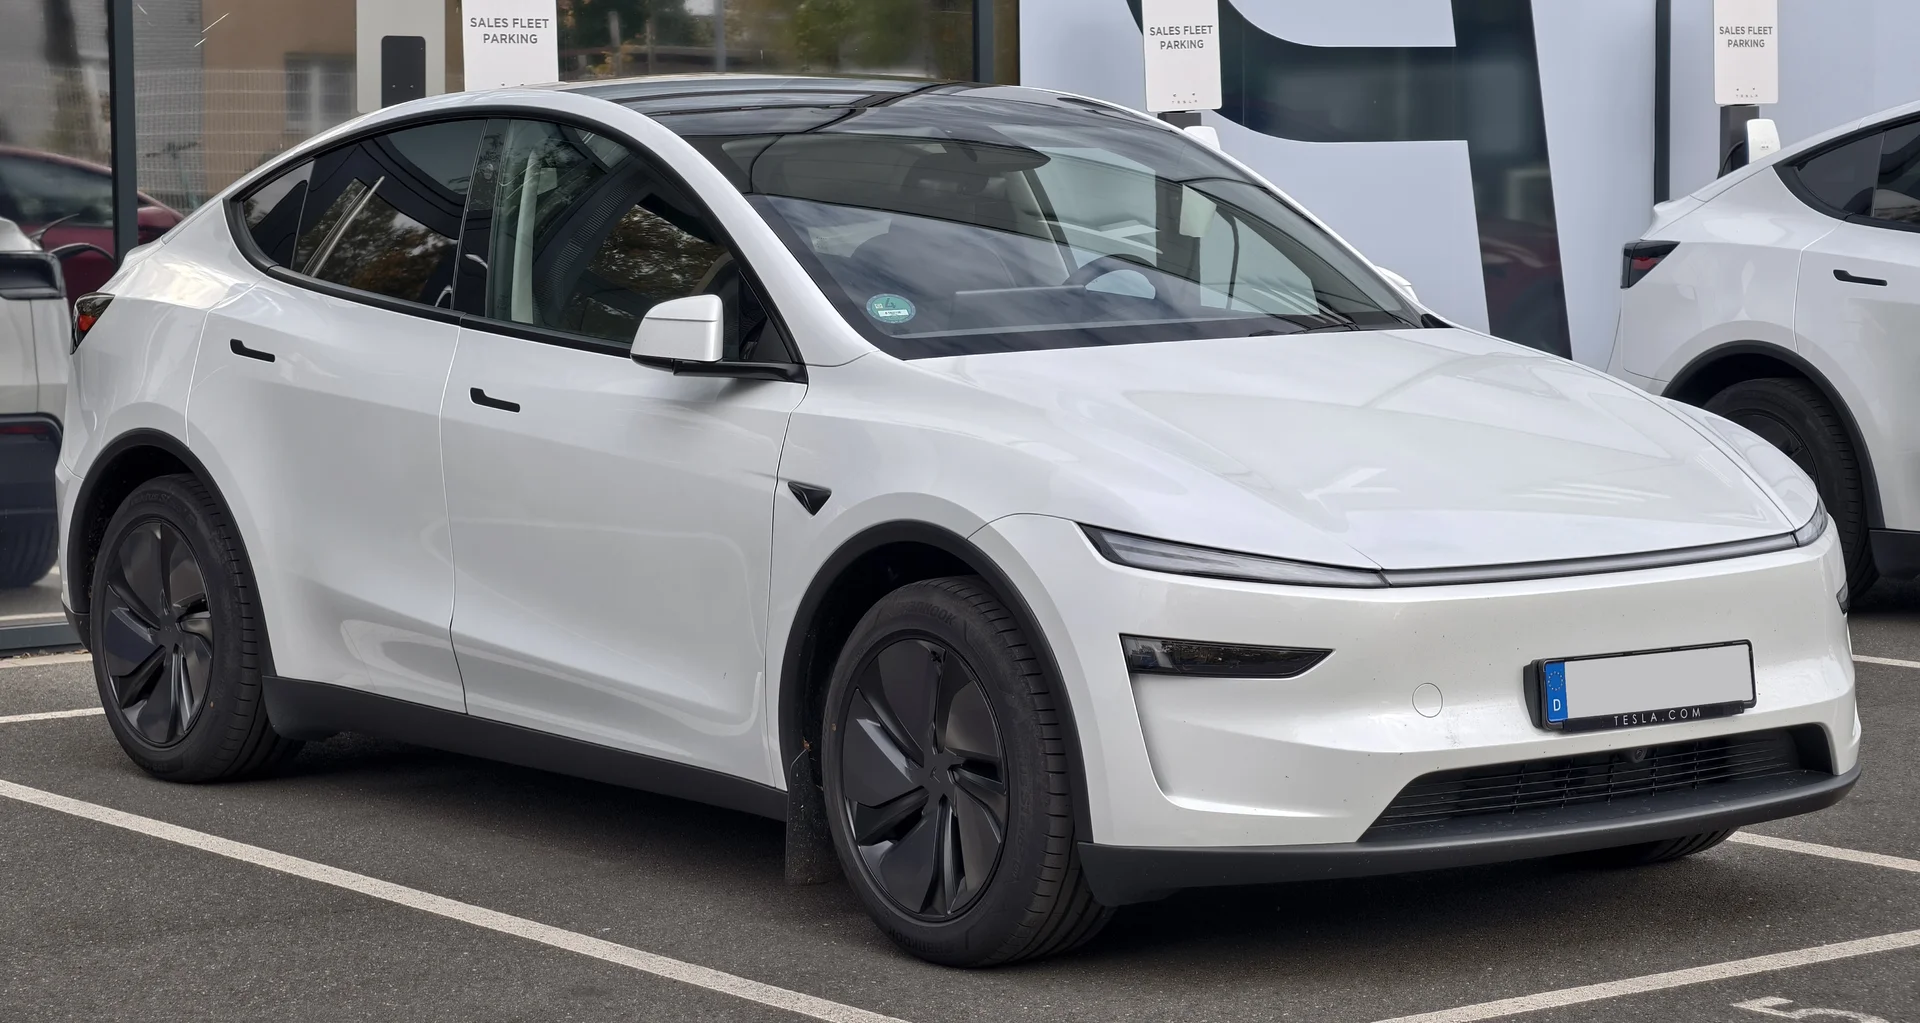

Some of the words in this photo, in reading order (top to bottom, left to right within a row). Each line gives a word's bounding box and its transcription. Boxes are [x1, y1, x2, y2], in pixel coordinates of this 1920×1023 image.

[470, 17, 509, 28] SALES
[512, 18, 549, 29] FLEET
[1149, 26, 1181, 36] SALES
[1183, 25, 1213, 35] FLEET
[1719, 26, 1746, 35] SALES
[1747, 26, 1773, 35] FLEET
[483, 33, 538, 44] PARKING
[1727, 39, 1765, 48] PARKING
[1160, 39, 1204, 50] PARKING
[1553, 698, 1561, 711] D
[1613, 707, 1702, 726] TESLA.COM
